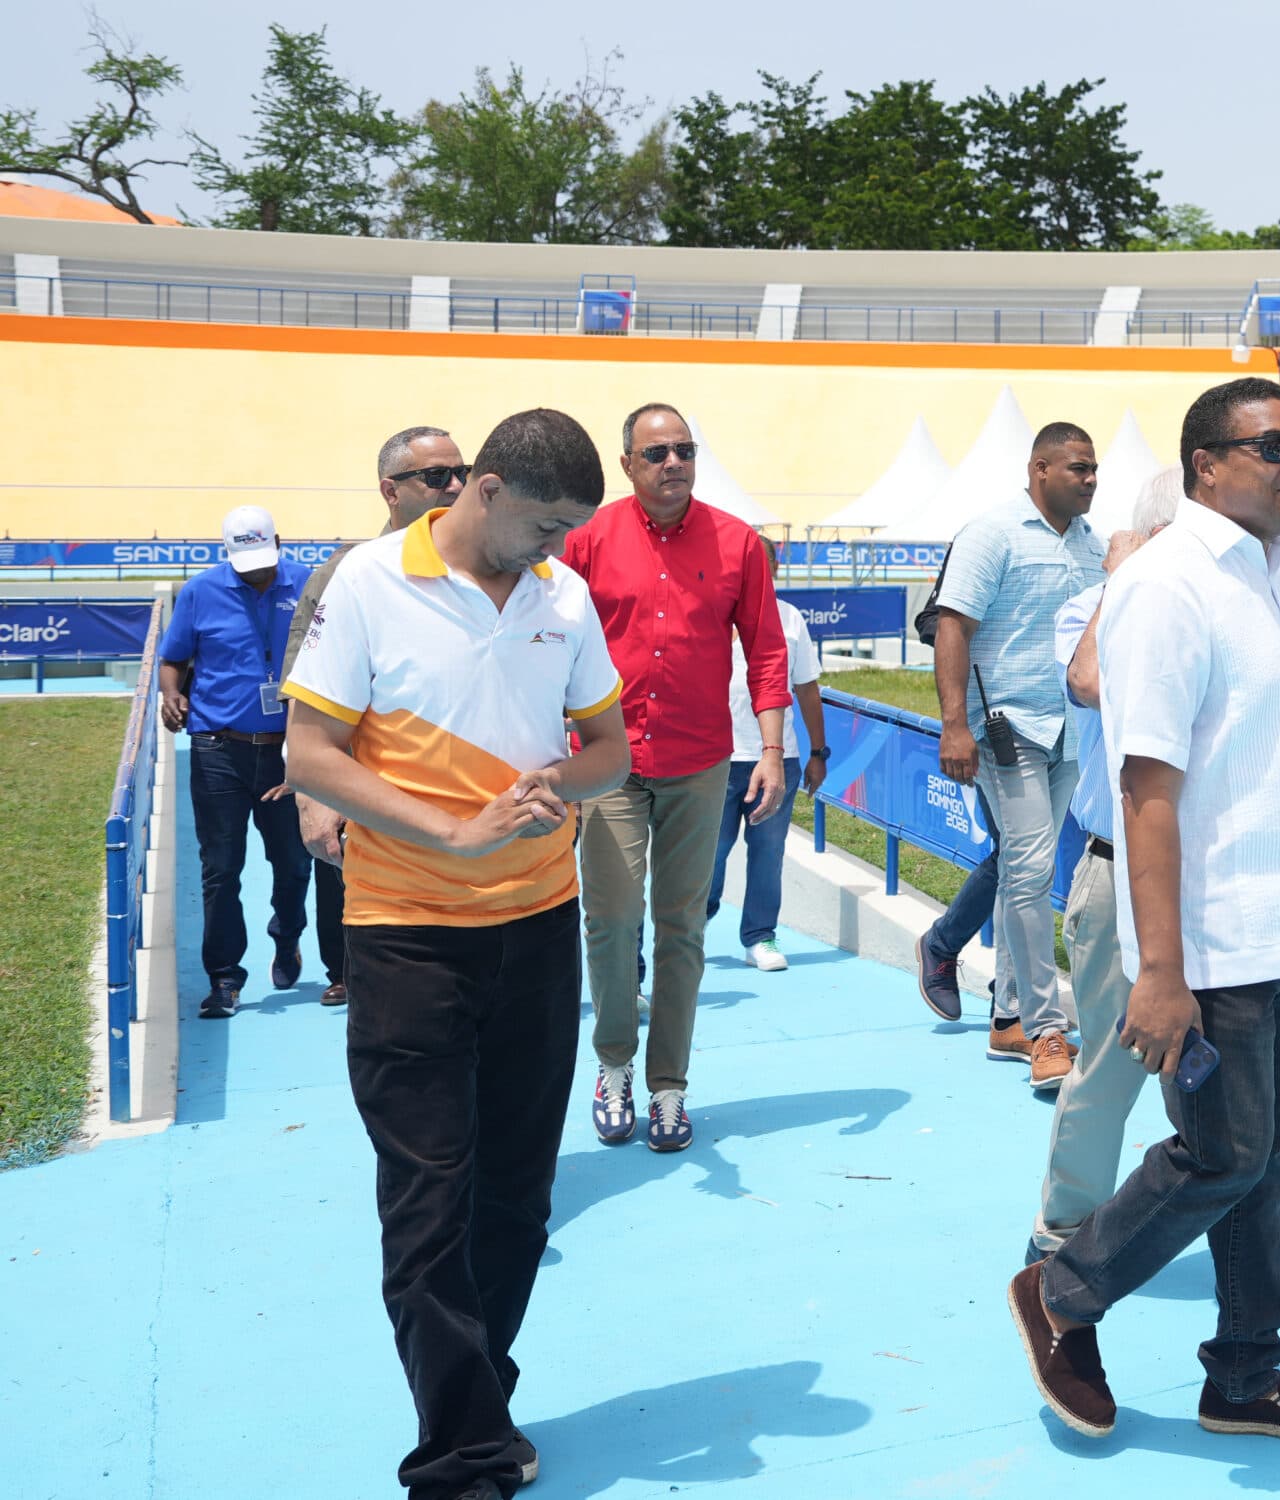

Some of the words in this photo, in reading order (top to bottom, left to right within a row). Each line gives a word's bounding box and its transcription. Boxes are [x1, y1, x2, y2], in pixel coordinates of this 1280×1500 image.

[113, 546, 215, 562] SANTO
[826, 548, 909, 564] SANTO
[0, 624, 59, 642] Claro
[927, 774, 957, 797] SANTO
[927, 789, 964, 816] DOMINGO
[946, 812, 969, 834] 2026
